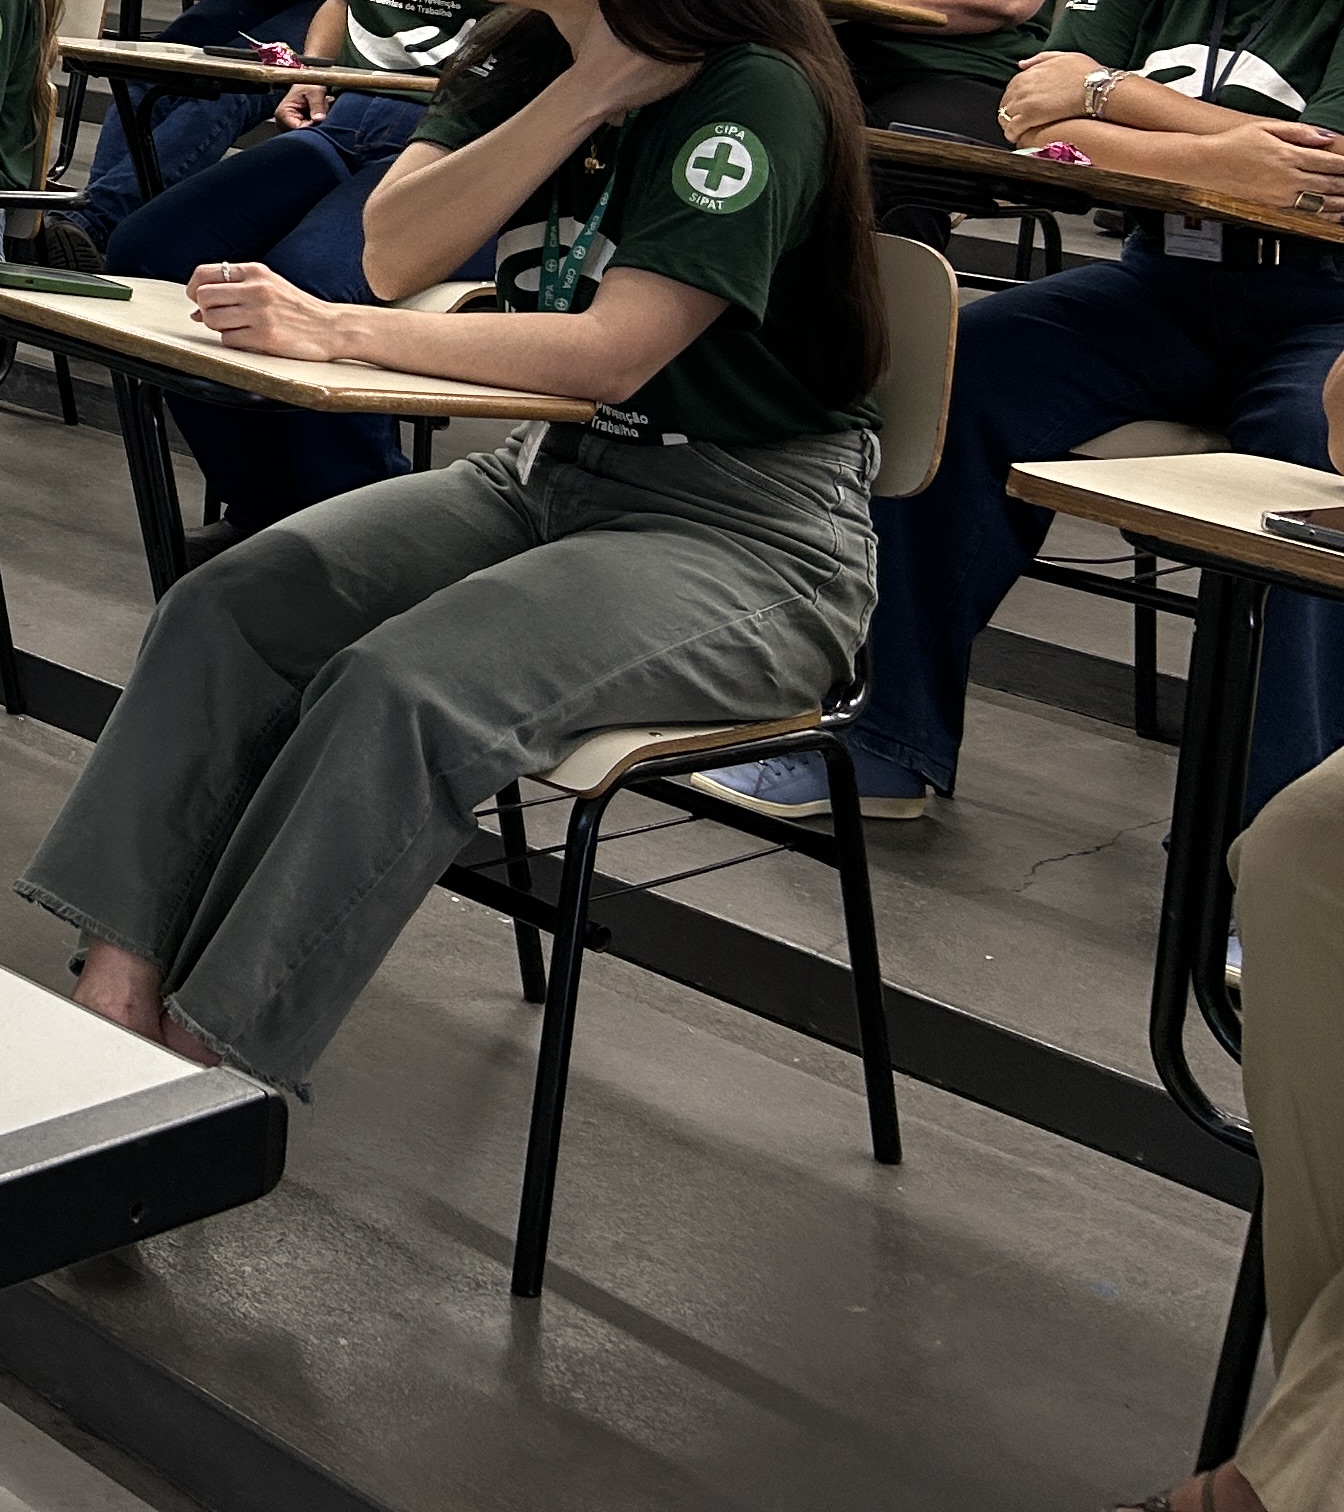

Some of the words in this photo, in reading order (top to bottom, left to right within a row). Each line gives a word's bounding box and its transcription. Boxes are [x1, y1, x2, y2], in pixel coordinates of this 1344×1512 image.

[405, 3, 416, 11] de
[417, 4, 453, 18] Trabalho
[714, 125, 745, 141] CIPA
[688, 192, 725, 210] SIPAT
[584, 215, 600, 236] CIPA
[562, 268, 576, 289] CIPA
[544, 284, 554, 307] CIPA
[592, 415, 640, 438] Trabalho
